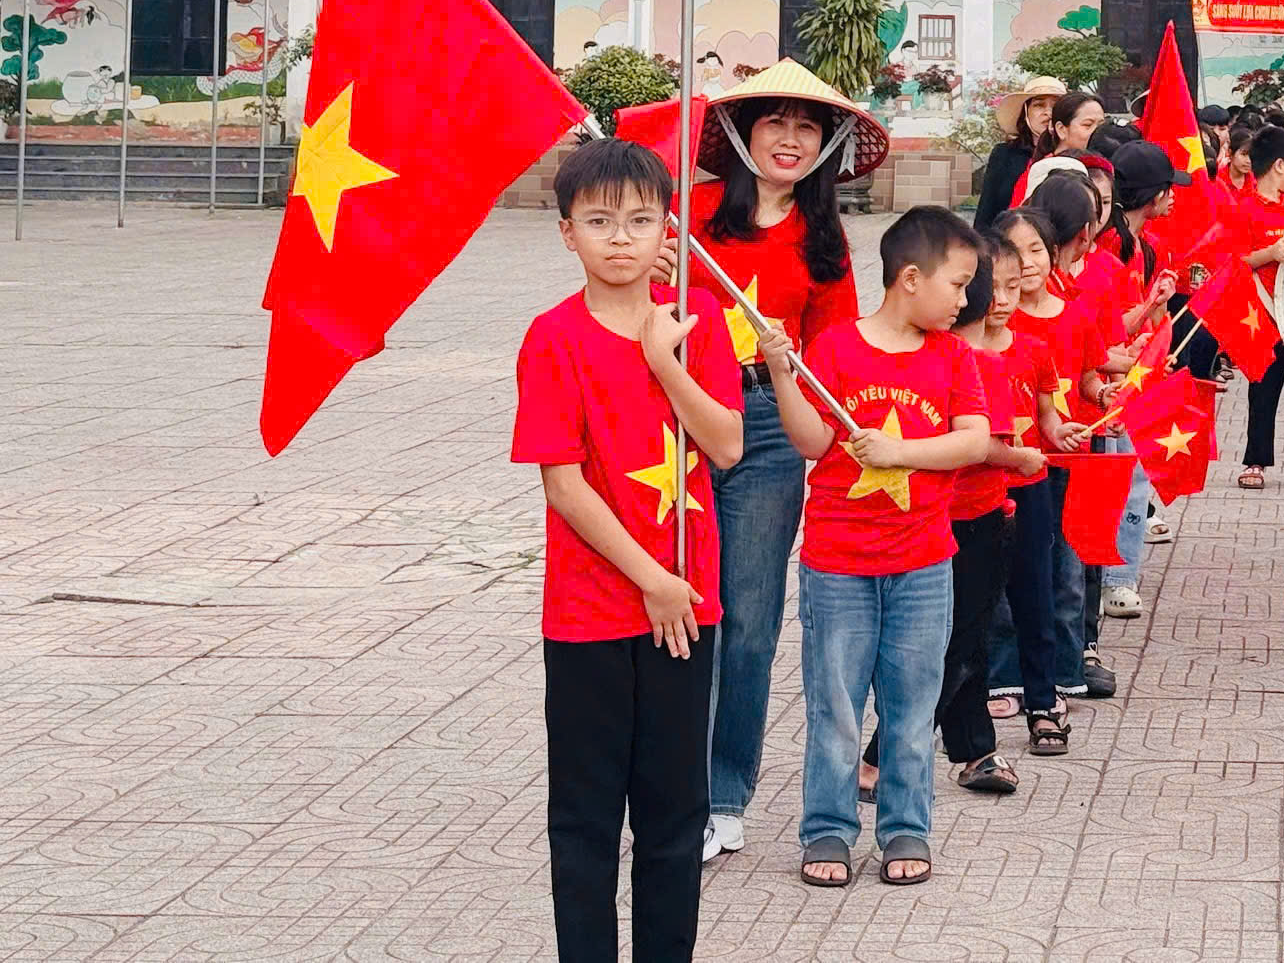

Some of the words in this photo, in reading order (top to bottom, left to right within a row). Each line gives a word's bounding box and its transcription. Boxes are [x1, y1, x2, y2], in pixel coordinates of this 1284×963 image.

[843, 395, 859, 413] ÔI
[859, 384, 888, 403] YÊU
[890, 387, 921, 406] VIỆT
[920, 398, 944, 427] NAM
